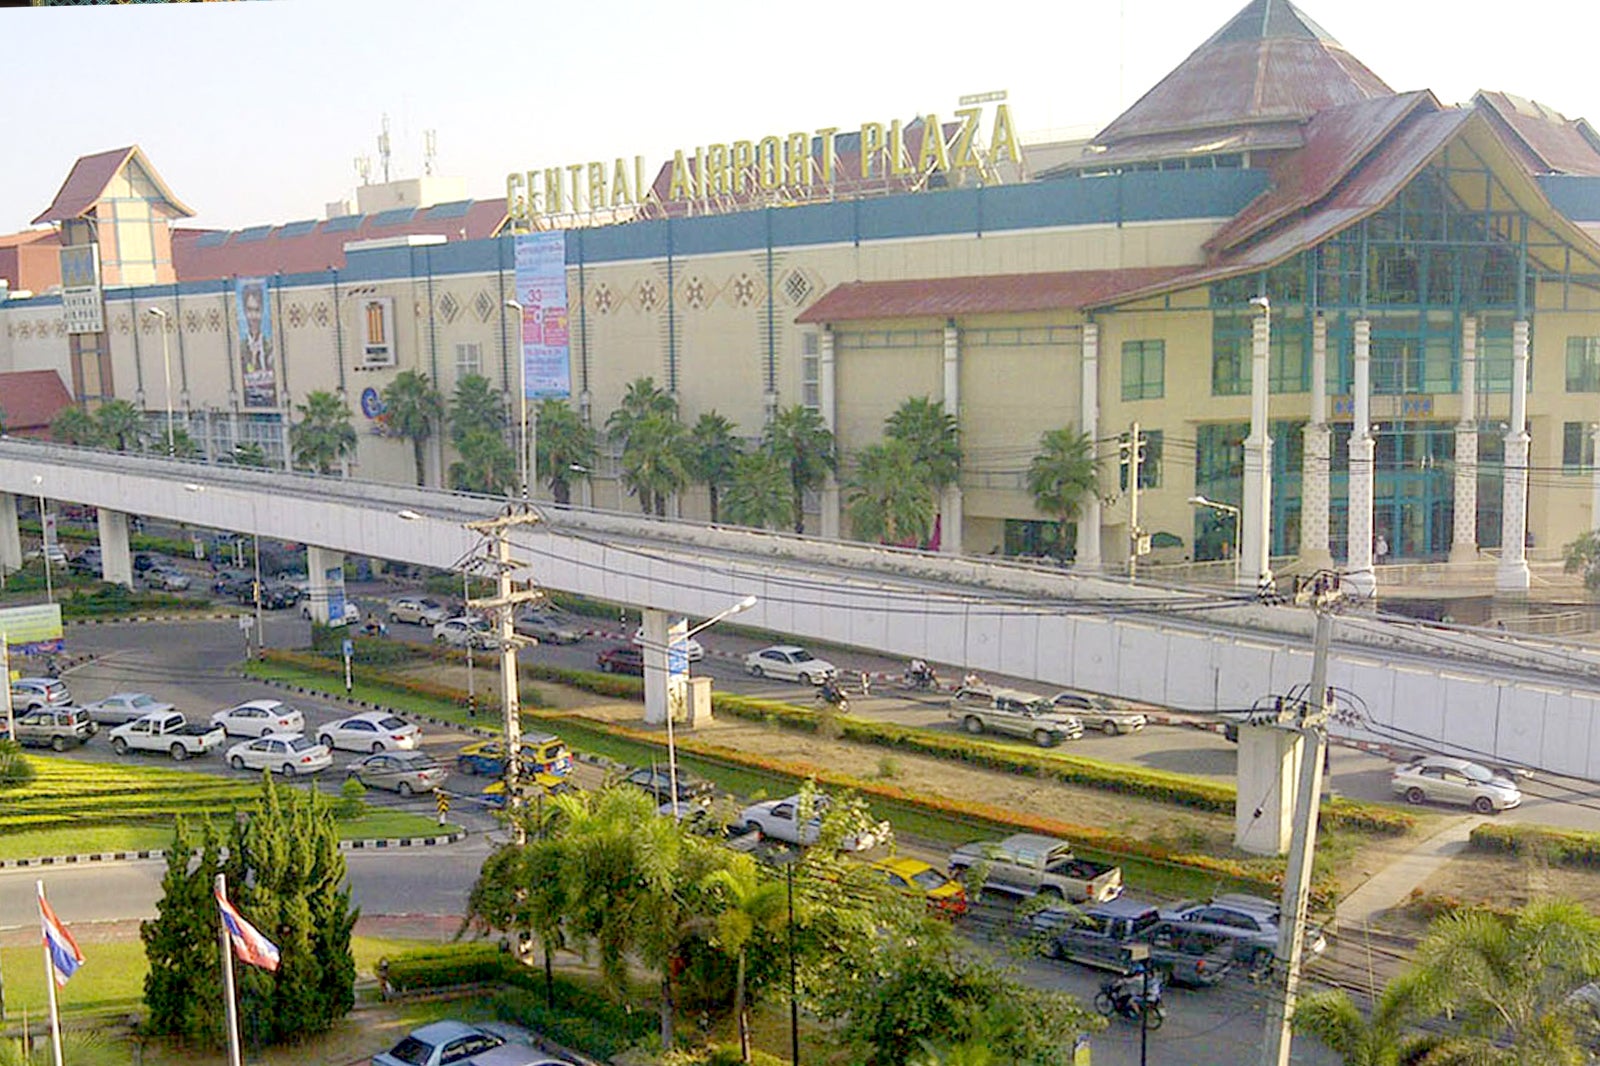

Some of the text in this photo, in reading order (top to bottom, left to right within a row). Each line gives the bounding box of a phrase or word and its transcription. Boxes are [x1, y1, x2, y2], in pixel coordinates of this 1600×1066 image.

[506, 104, 1022, 219] CENTRAL AIRPORT PLAZA
